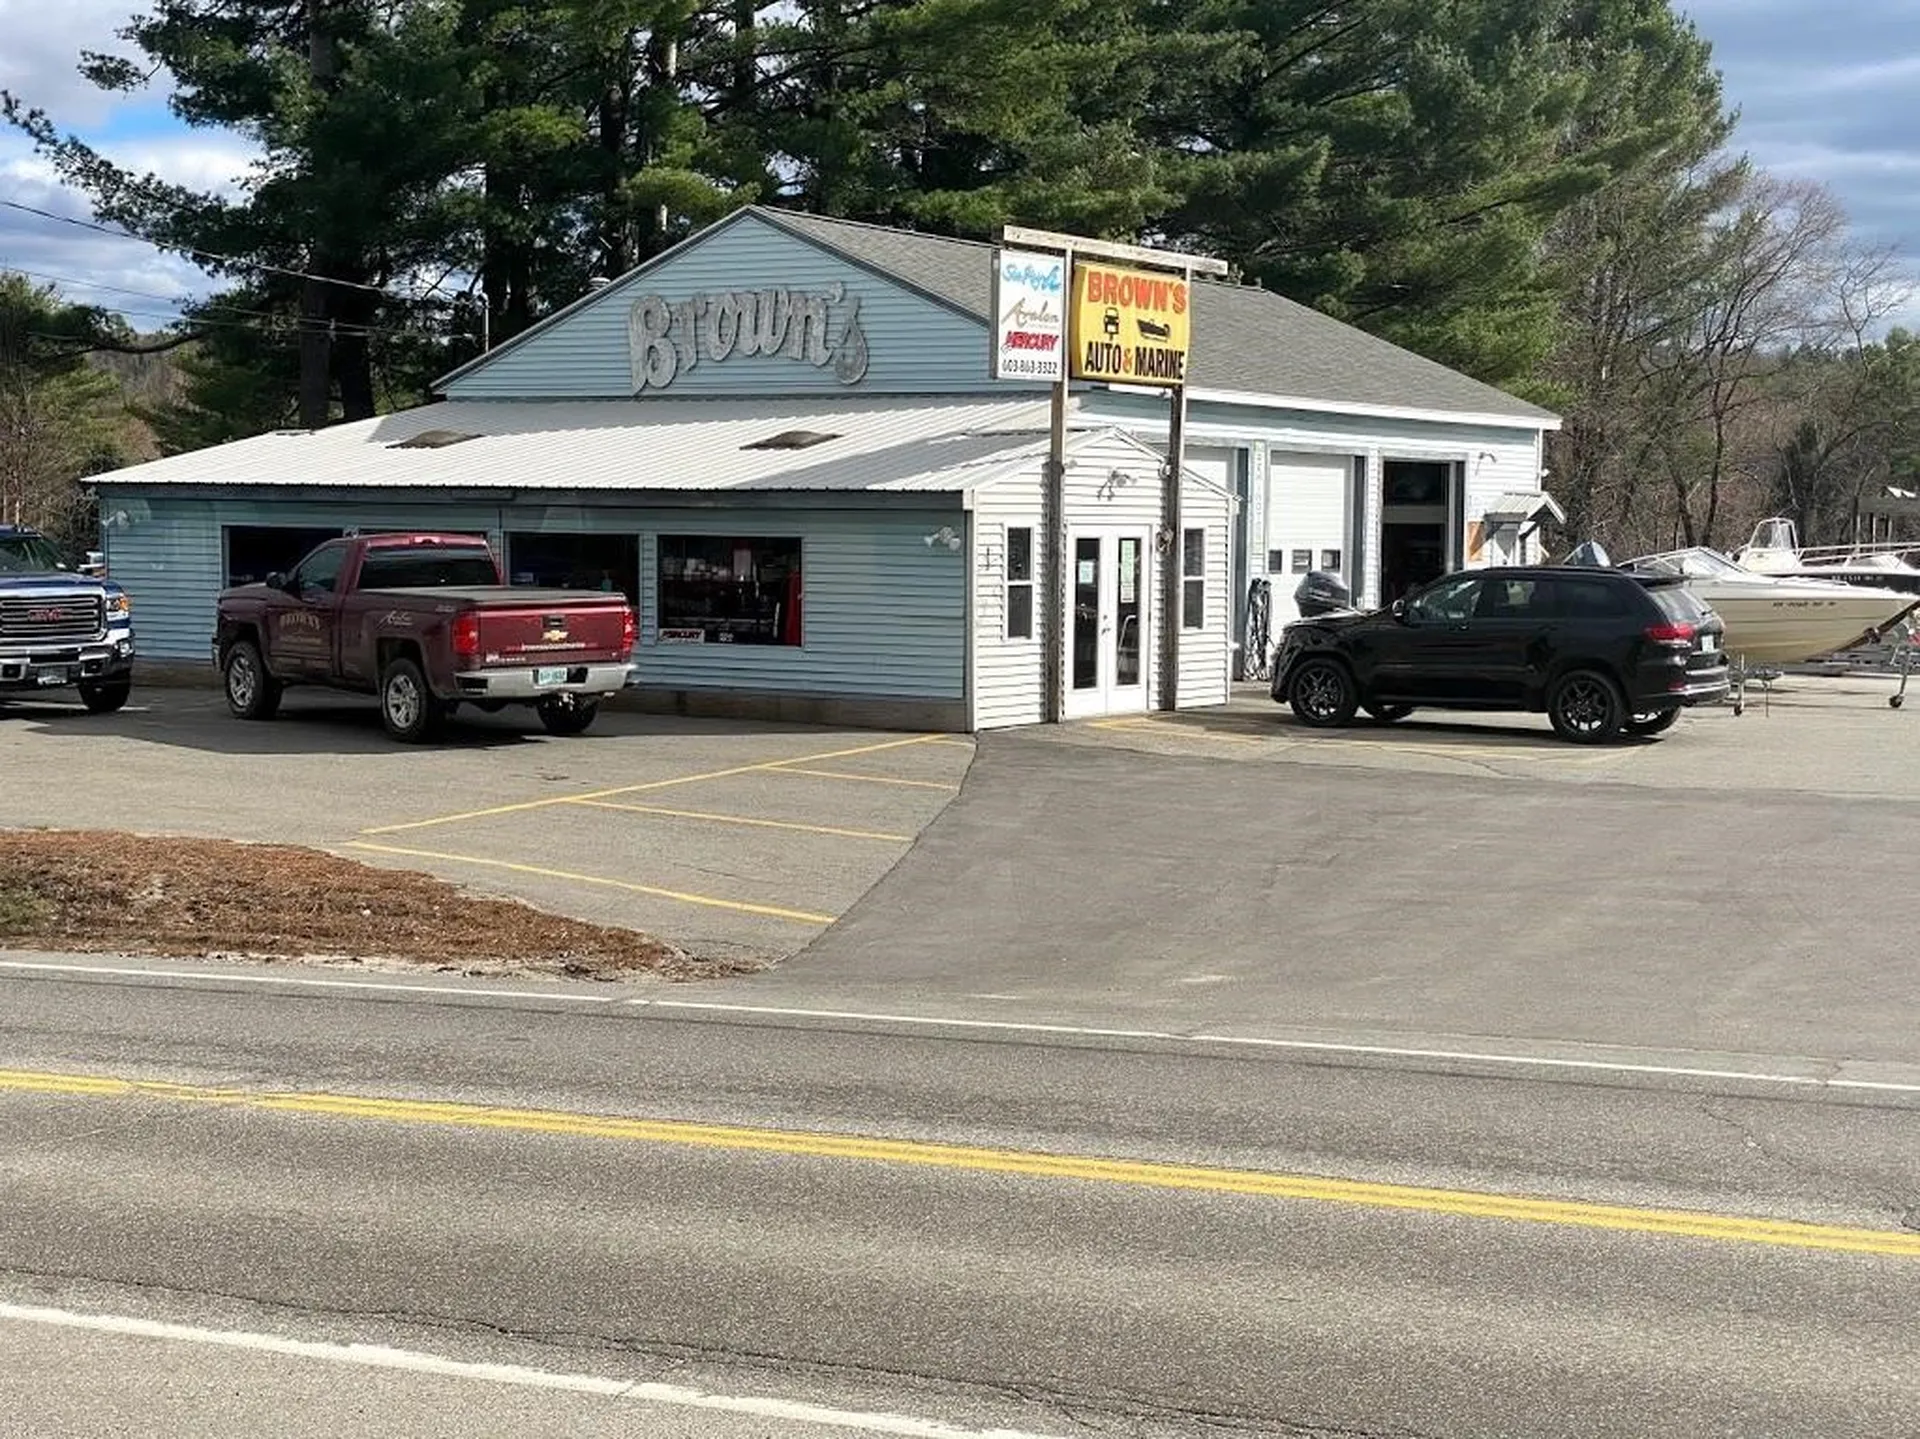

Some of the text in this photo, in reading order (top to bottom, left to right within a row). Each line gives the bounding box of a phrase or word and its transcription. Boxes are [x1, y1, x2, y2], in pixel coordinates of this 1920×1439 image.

[1087, 271, 1187, 314] BROWN'S
[629, 281, 868, 395] Brown's
[1005, 331, 1059, 351] MERCURY
[1085, 341, 1185, 379] AUTO & MARINE
[28, 608, 61, 622] GMC
